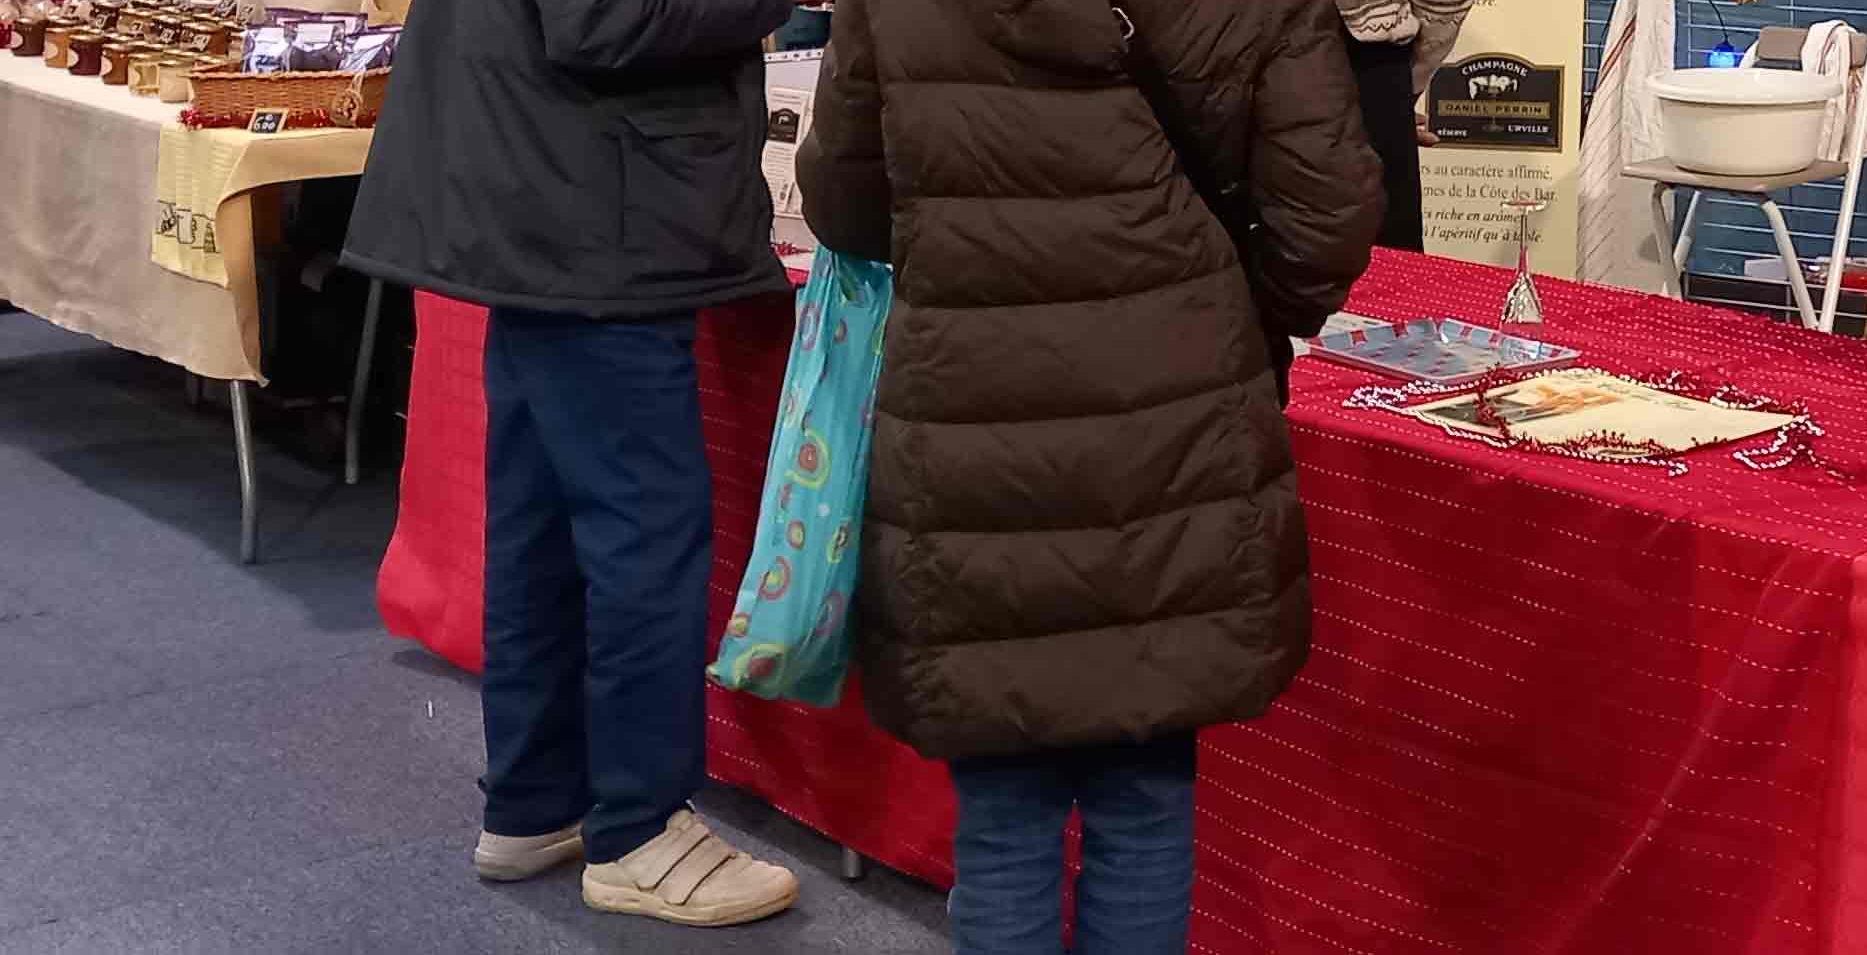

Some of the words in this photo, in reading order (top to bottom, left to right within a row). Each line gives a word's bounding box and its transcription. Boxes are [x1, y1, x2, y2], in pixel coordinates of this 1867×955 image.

[1462, 60, 1528, 77] CHAMPAGNE
[1446, 103, 1488, 113] DANIEL
[1496, 105, 1542, 114] PERRIN
[1508, 124, 1549, 134] URVILLE
[1451, 164, 1504, 178] caractère
[1449, 184, 1462, 198] de
[1466, 184, 1476, 198] la
[1480, 185, 1508, 200] Côte
[1511, 186, 1530, 201] des
[1435, 207, 1463, 221] riche
[1466, 212, 1480, 222] en
[1483, 210, 1522, 223] arôme
